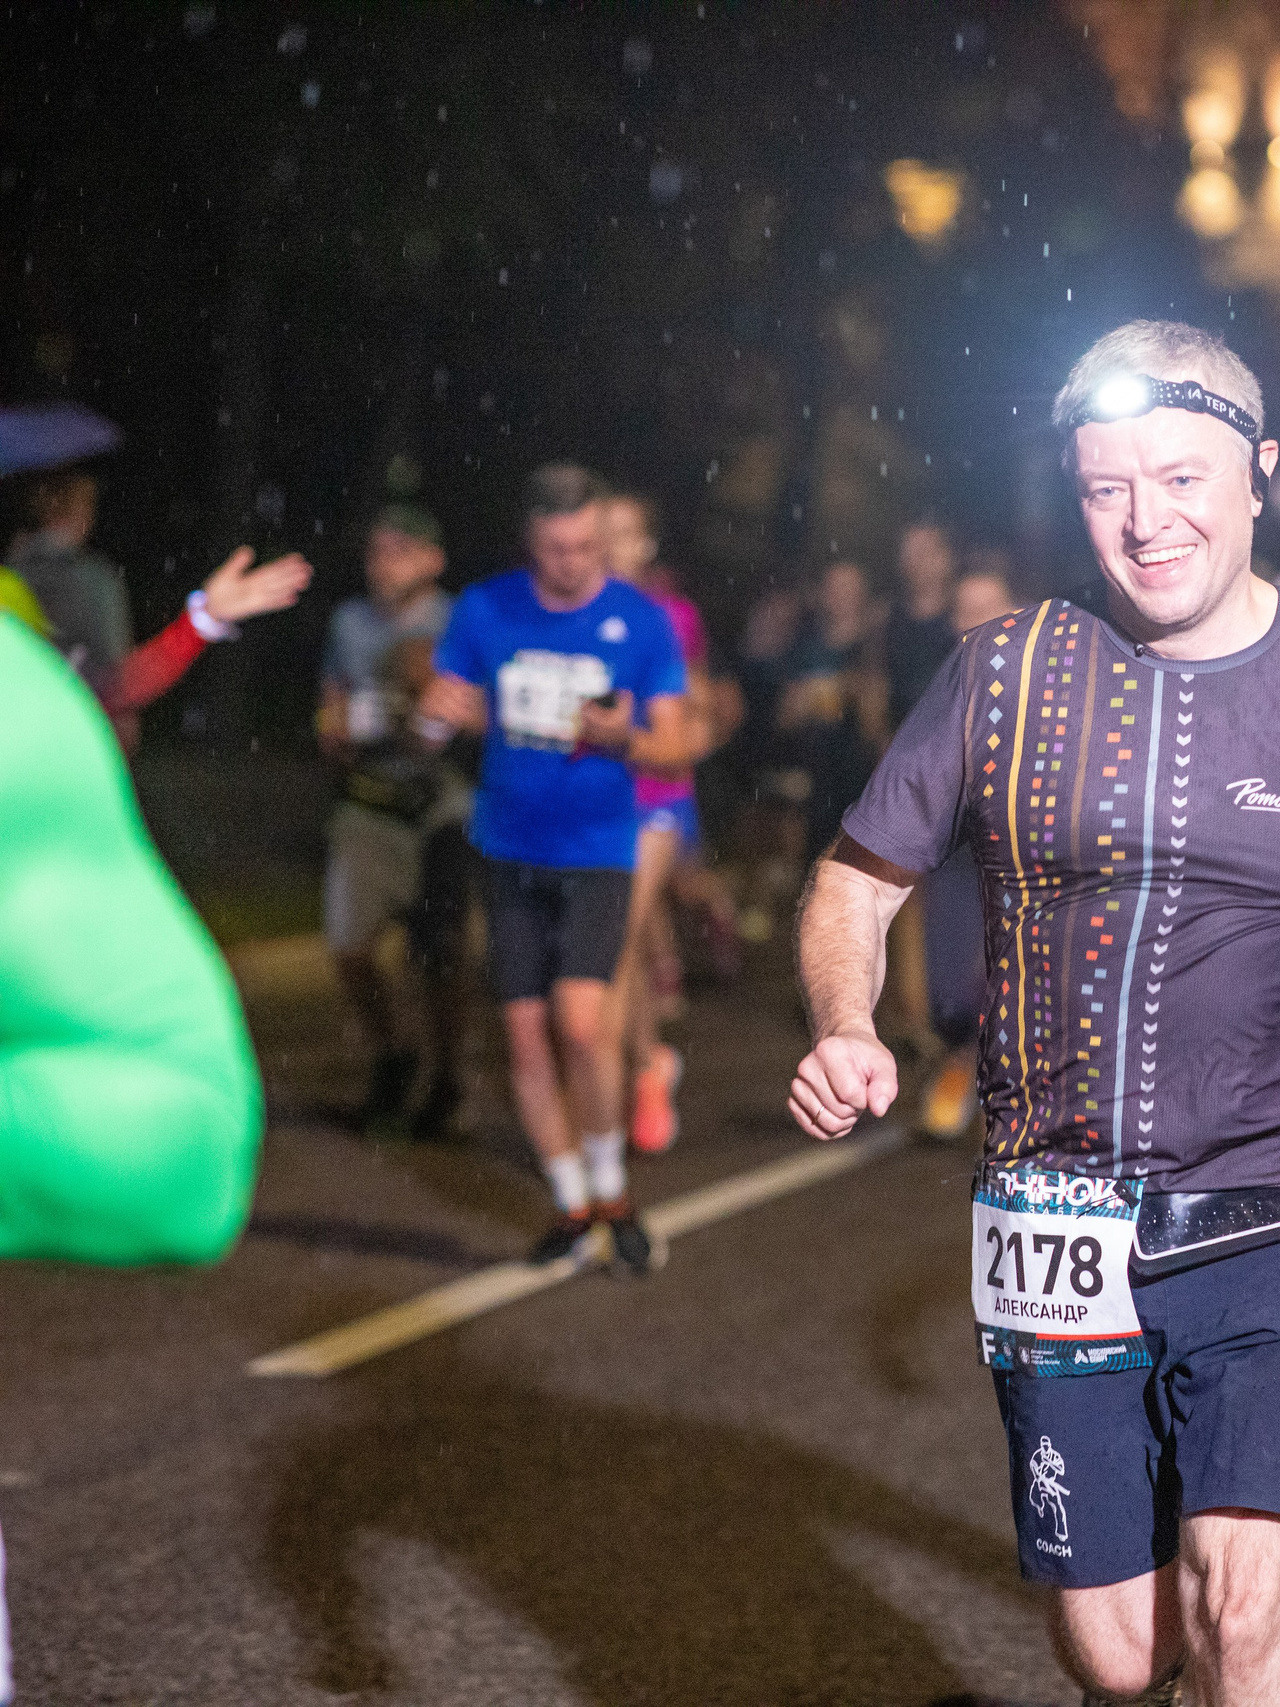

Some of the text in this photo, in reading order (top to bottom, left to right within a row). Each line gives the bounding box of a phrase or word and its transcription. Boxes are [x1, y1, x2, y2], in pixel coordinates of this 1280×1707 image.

[986, 1225, 1104, 1298] 2178
[994, 1296, 1089, 1324] АЛЕКСАНДР
[1036, 1538, 1073, 1558] COACH
